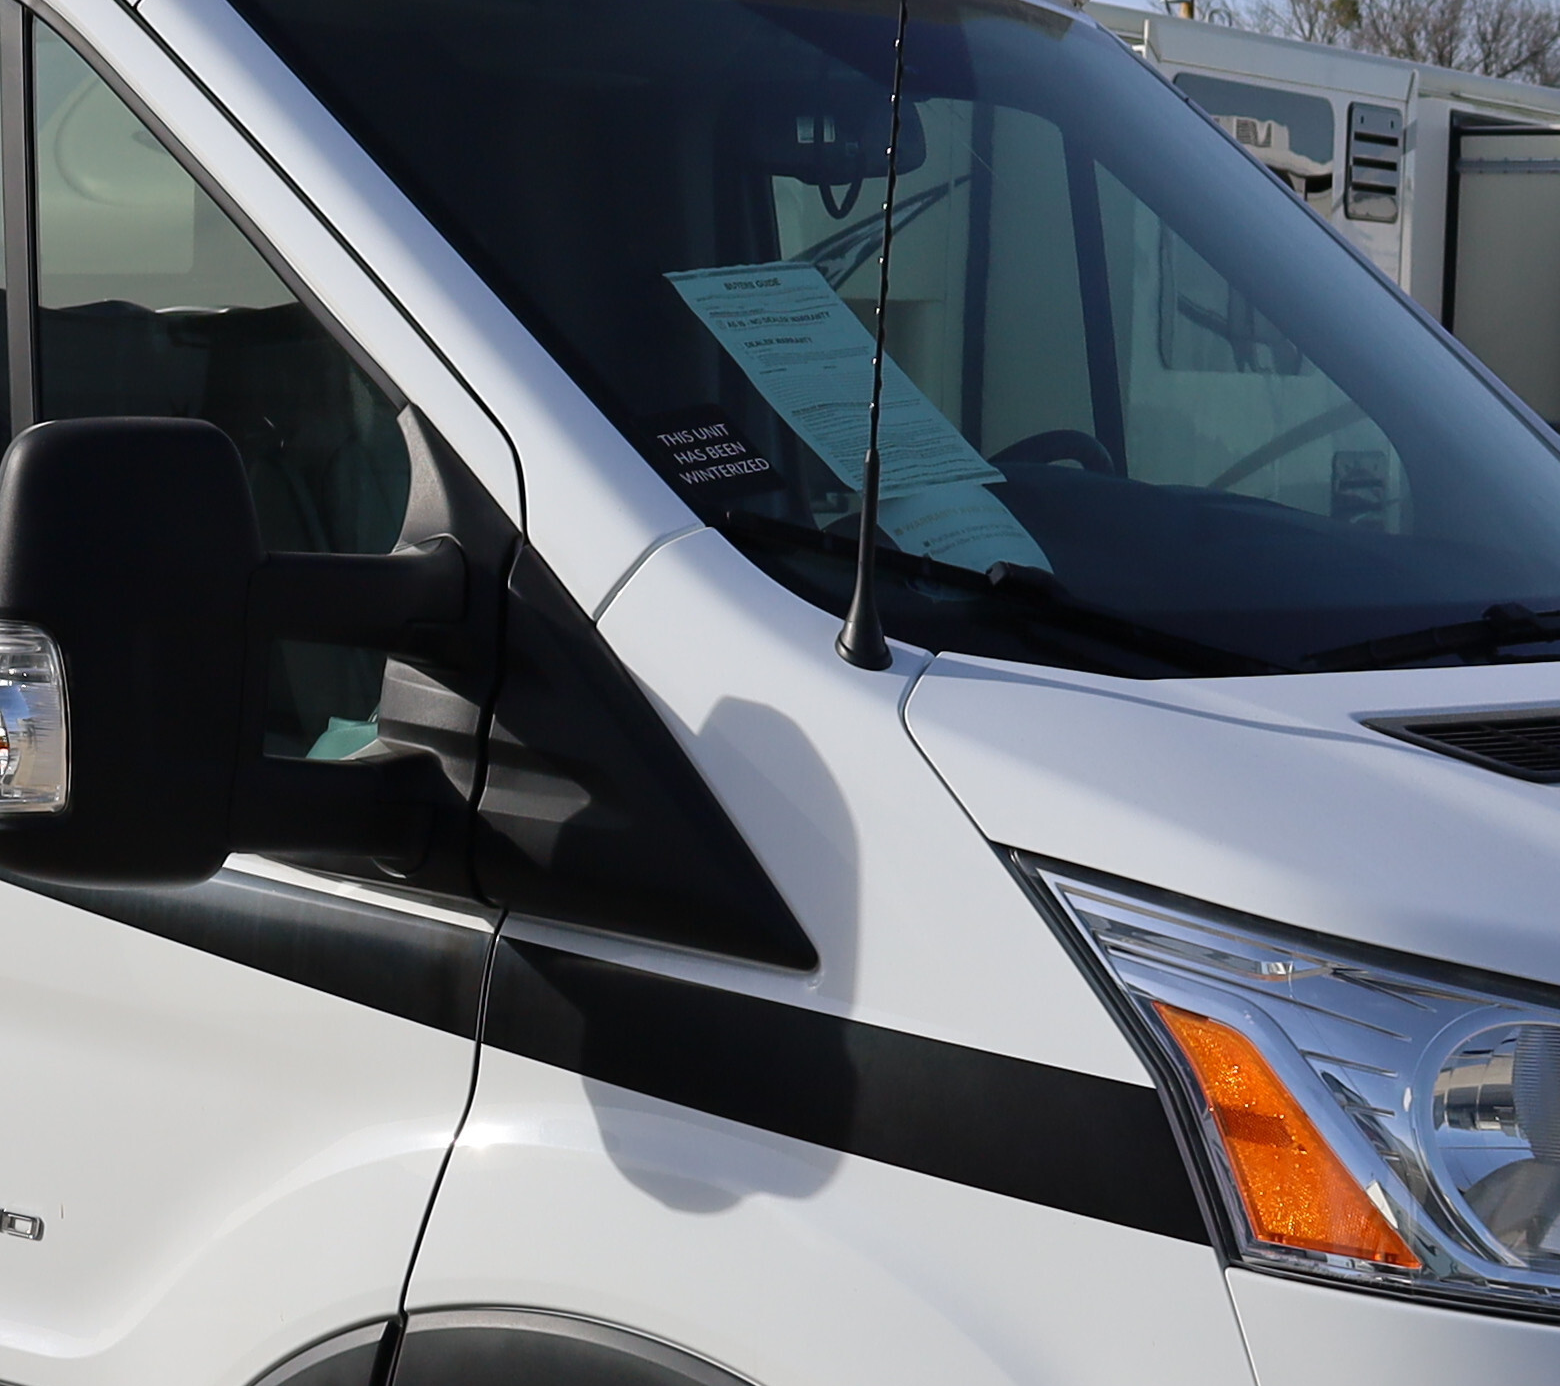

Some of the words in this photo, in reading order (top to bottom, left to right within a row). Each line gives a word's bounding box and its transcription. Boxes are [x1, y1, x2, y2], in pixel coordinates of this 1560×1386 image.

[657, 429, 695, 447] THIS
[692, 423, 730, 441] UNIT
[673, 448, 707, 465] HAS
[705, 441, 747, 460] BEEN
[679, 457, 770, 485] WINTERIZED
